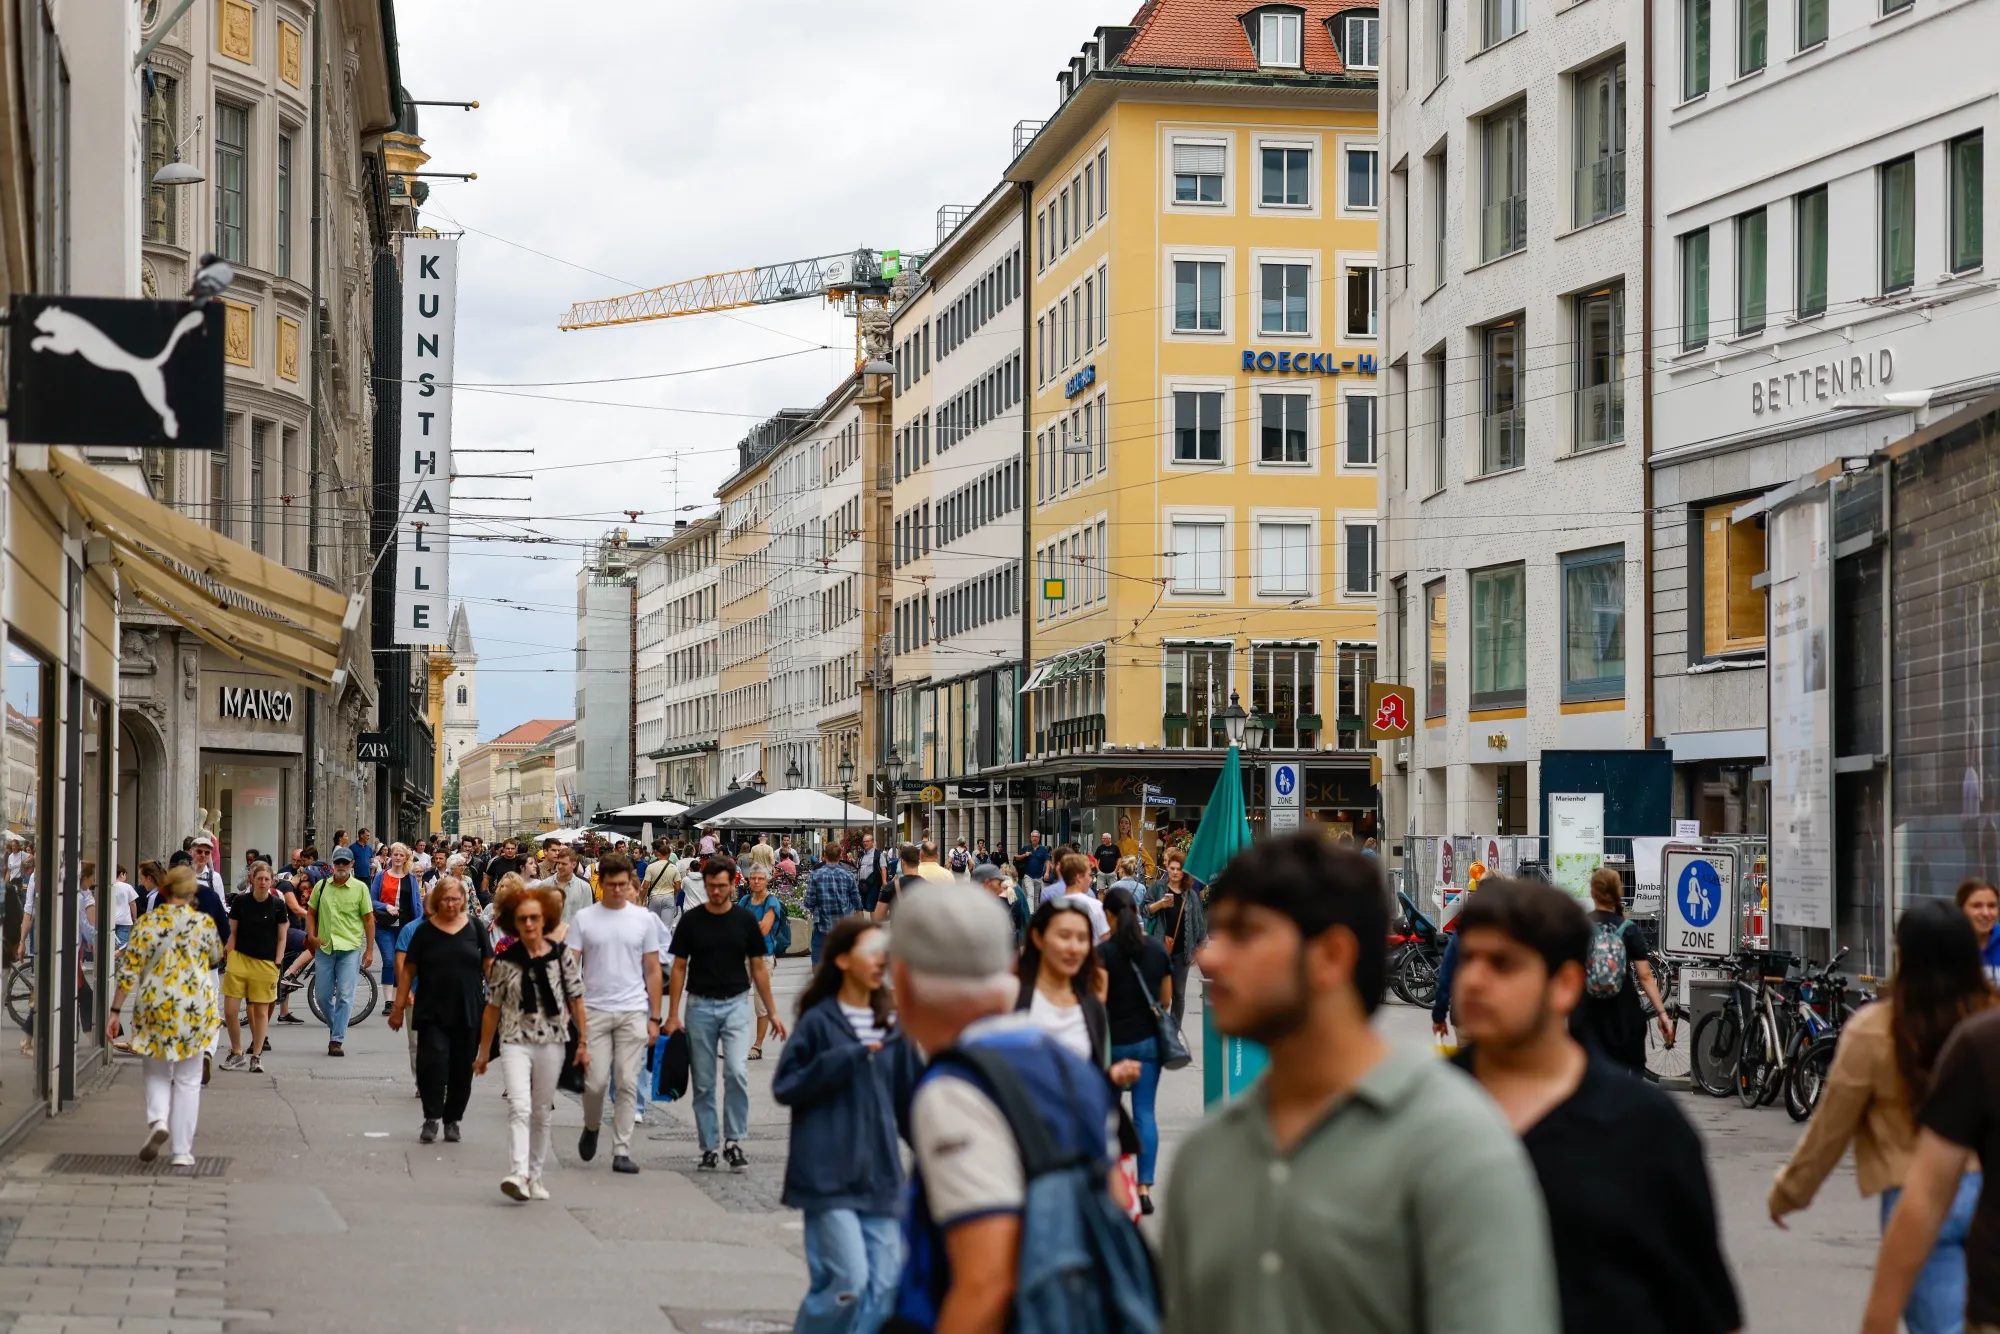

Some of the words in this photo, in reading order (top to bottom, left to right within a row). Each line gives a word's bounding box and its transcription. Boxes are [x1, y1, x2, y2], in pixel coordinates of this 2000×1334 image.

[1752, 348, 1895, 414] BETTENRID
[412, 254, 440, 629] KUNSTHALLE
[220, 686, 294, 722] MANGO
[358, 742, 389, 758] ZARA
[1277, 796, 1293, 805] ZONE
[1637, 882, 1662, 891] Umba
[1636, 892, 1662, 901] Räum
[1681, 931, 1715, 949] ZONE
